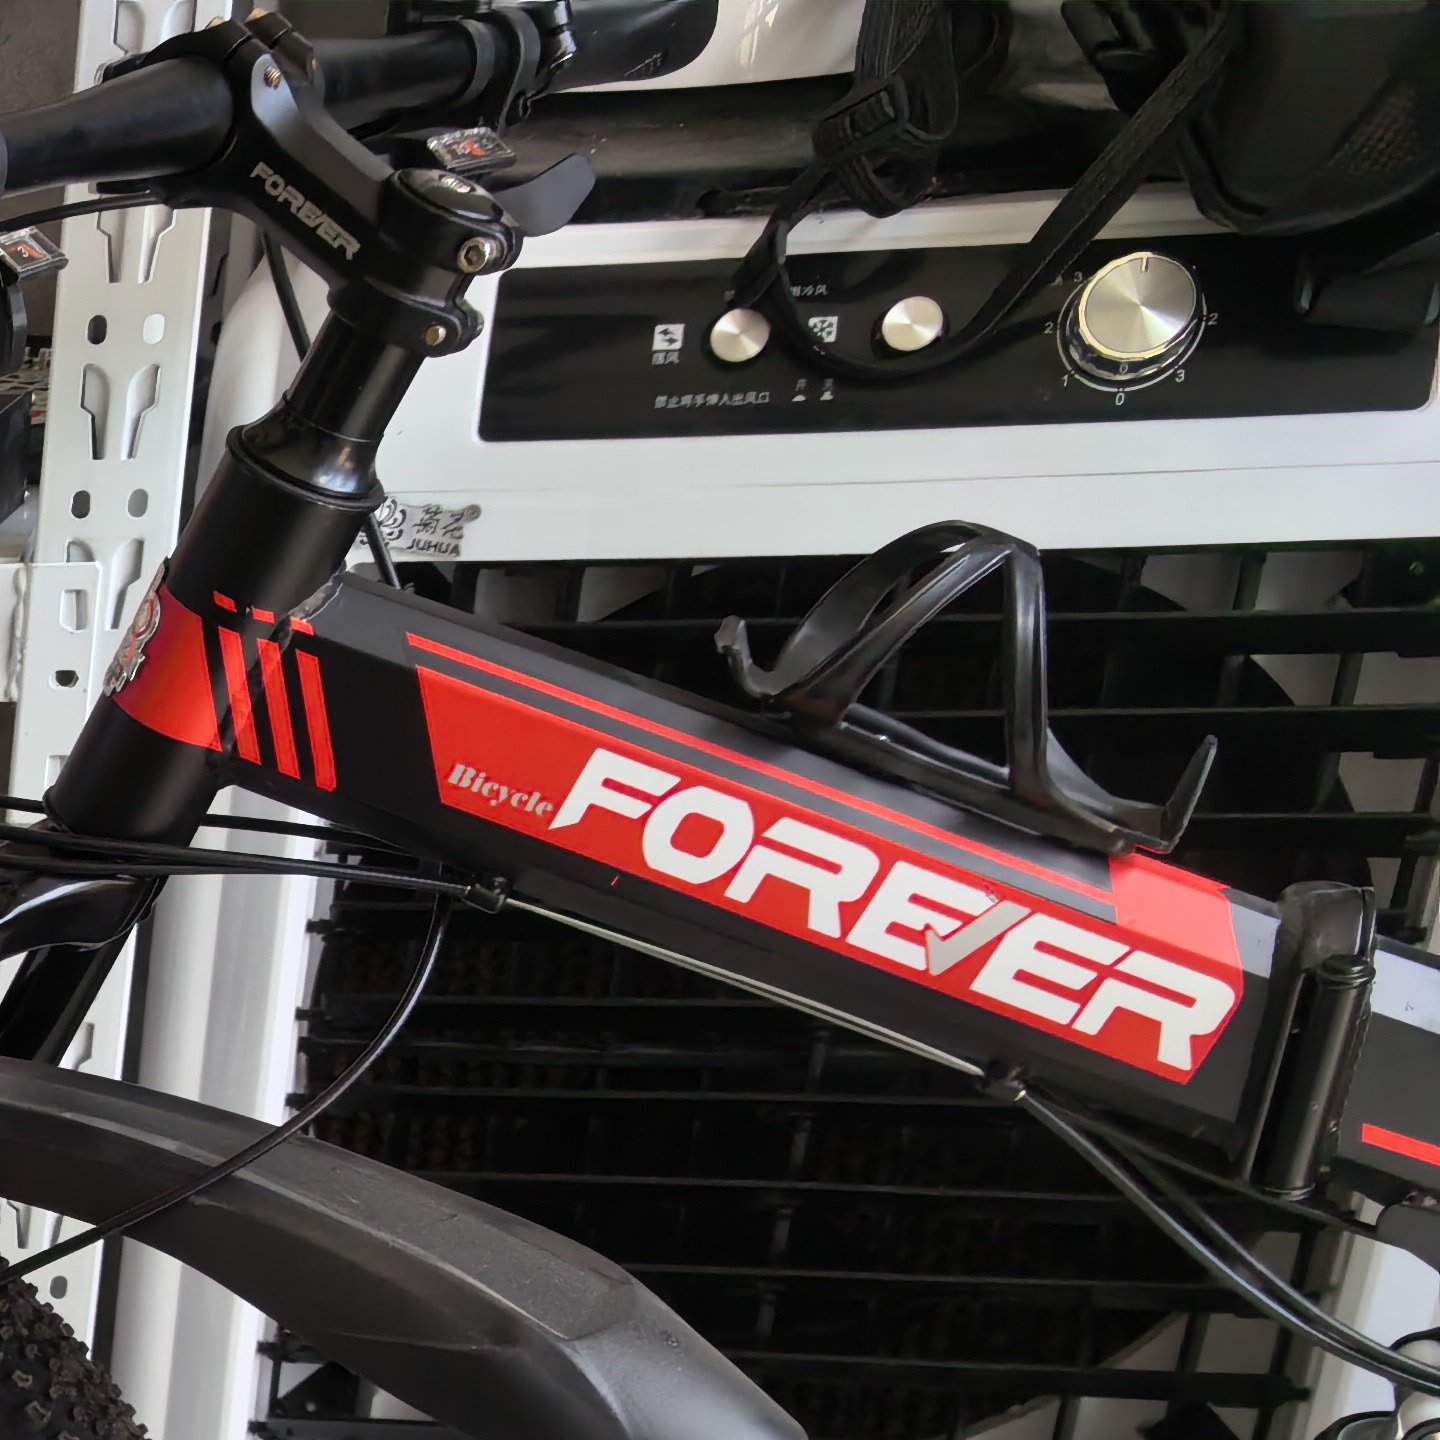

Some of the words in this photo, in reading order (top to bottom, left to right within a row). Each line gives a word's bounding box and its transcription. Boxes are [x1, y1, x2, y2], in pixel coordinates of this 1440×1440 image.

[1208, 312, 1219, 326] 2
[1043, 322, 1054, 334] 2
[1175, 369, 1186, 383] 3
[1114, 392, 1126, 406] 0
[406, 538, 462, 559] JUHUA
[448, 761, 556, 821] Bicycle
[548, 746, 1236, 1073] FOREVER
